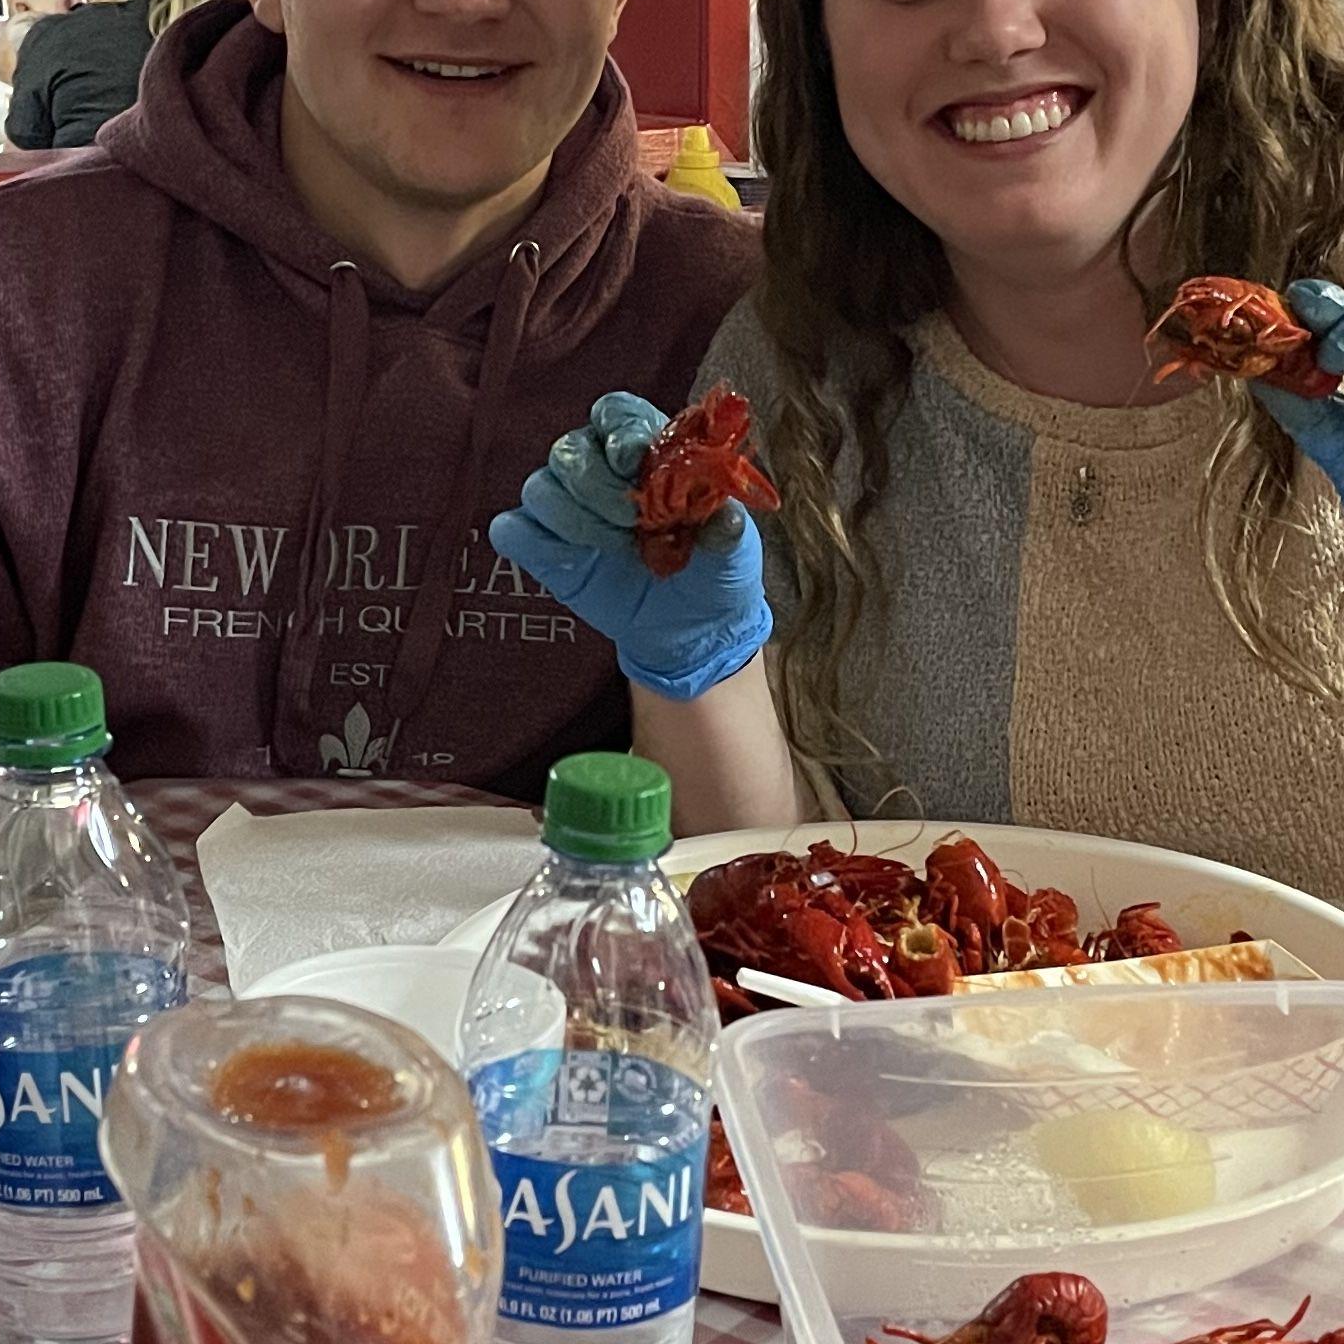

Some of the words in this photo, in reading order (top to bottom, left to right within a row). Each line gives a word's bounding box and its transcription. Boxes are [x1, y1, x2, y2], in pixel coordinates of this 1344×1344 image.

[123, 517, 289, 596] NEW
[358, 605, 576, 643] QURTER
[330, 663, 392, 687] EST
[24, 1156, 74, 1168] WATER
[58, 1189, 80, 1202] 500
[504, 1166, 692, 1254] ASANI
[519, 1266, 588, 1287] PURIFIED
[592, 1269, 642, 1288] WATER
[521, 1301, 536, 1318] FL
[540, 1305, 556, 1322] OZ
[596, 1308, 618, 1324] PT)
[621, 1303, 643, 1320] 500
